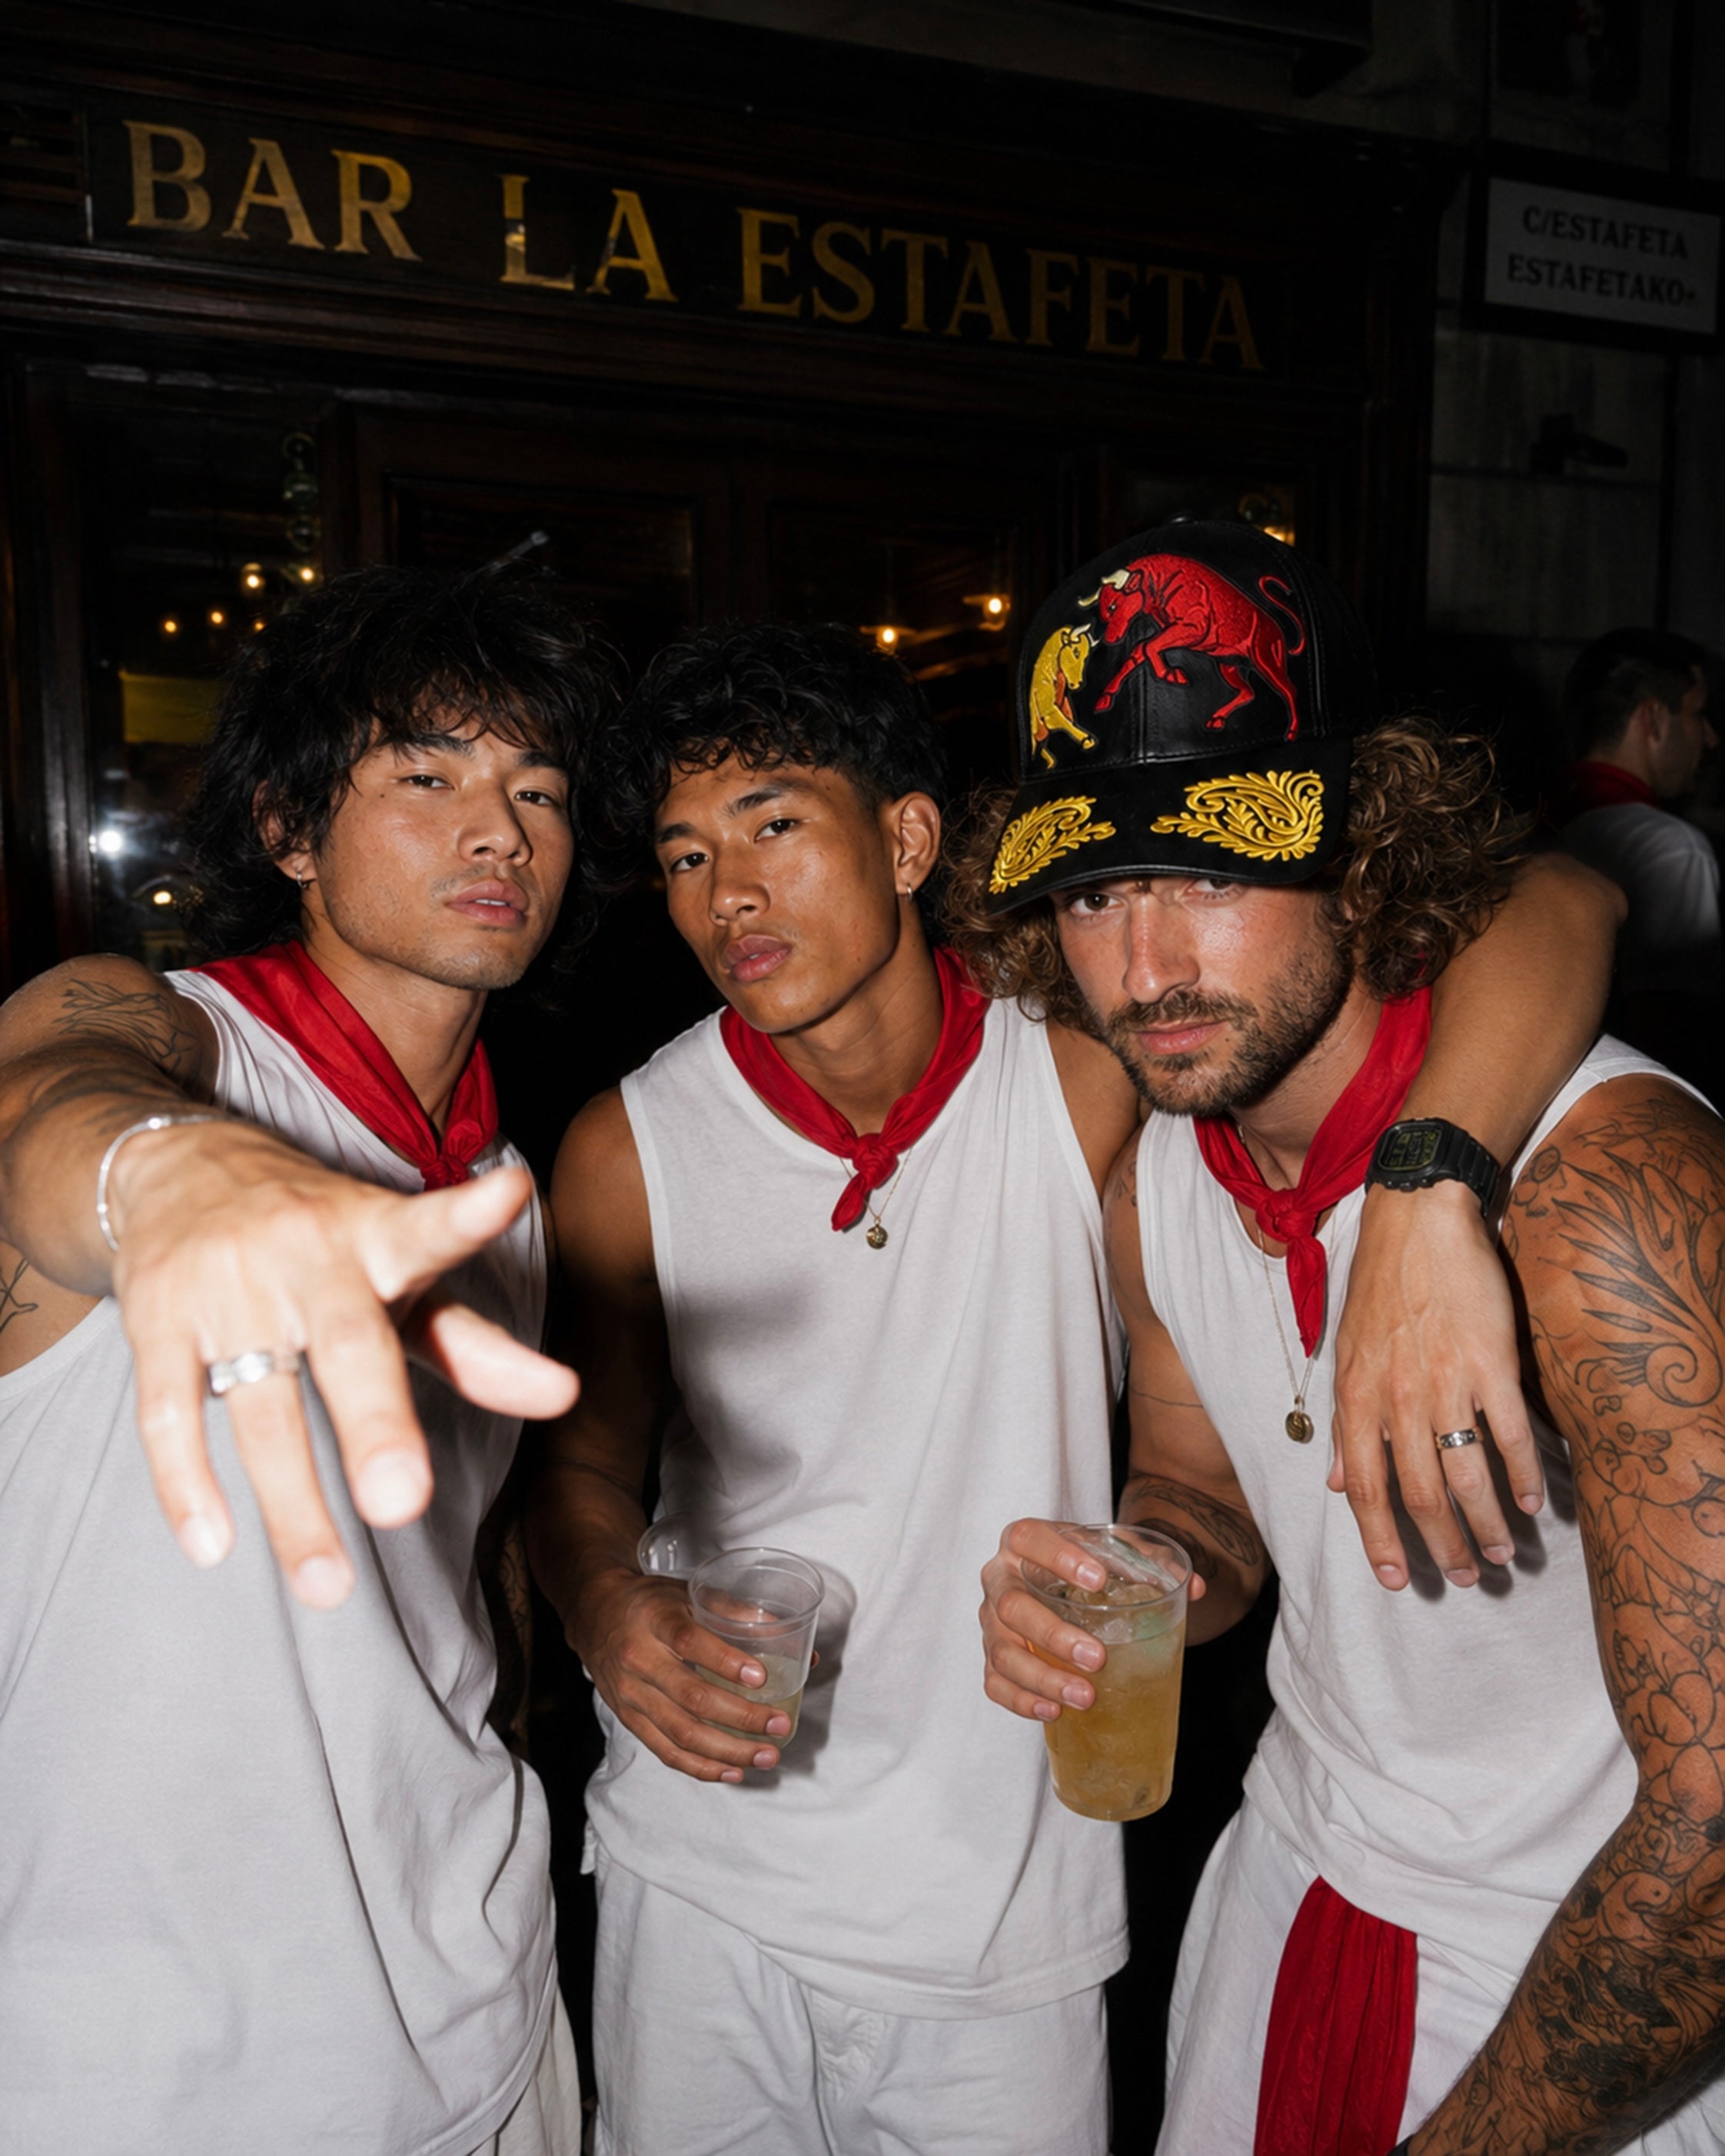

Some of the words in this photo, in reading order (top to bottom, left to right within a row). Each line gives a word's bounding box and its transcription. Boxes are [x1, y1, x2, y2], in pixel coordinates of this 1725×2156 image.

[123, 120, 422, 261] BAR
[498, 175, 678, 302] LA
[736, 207, 1265, 371] ESTAFETA
